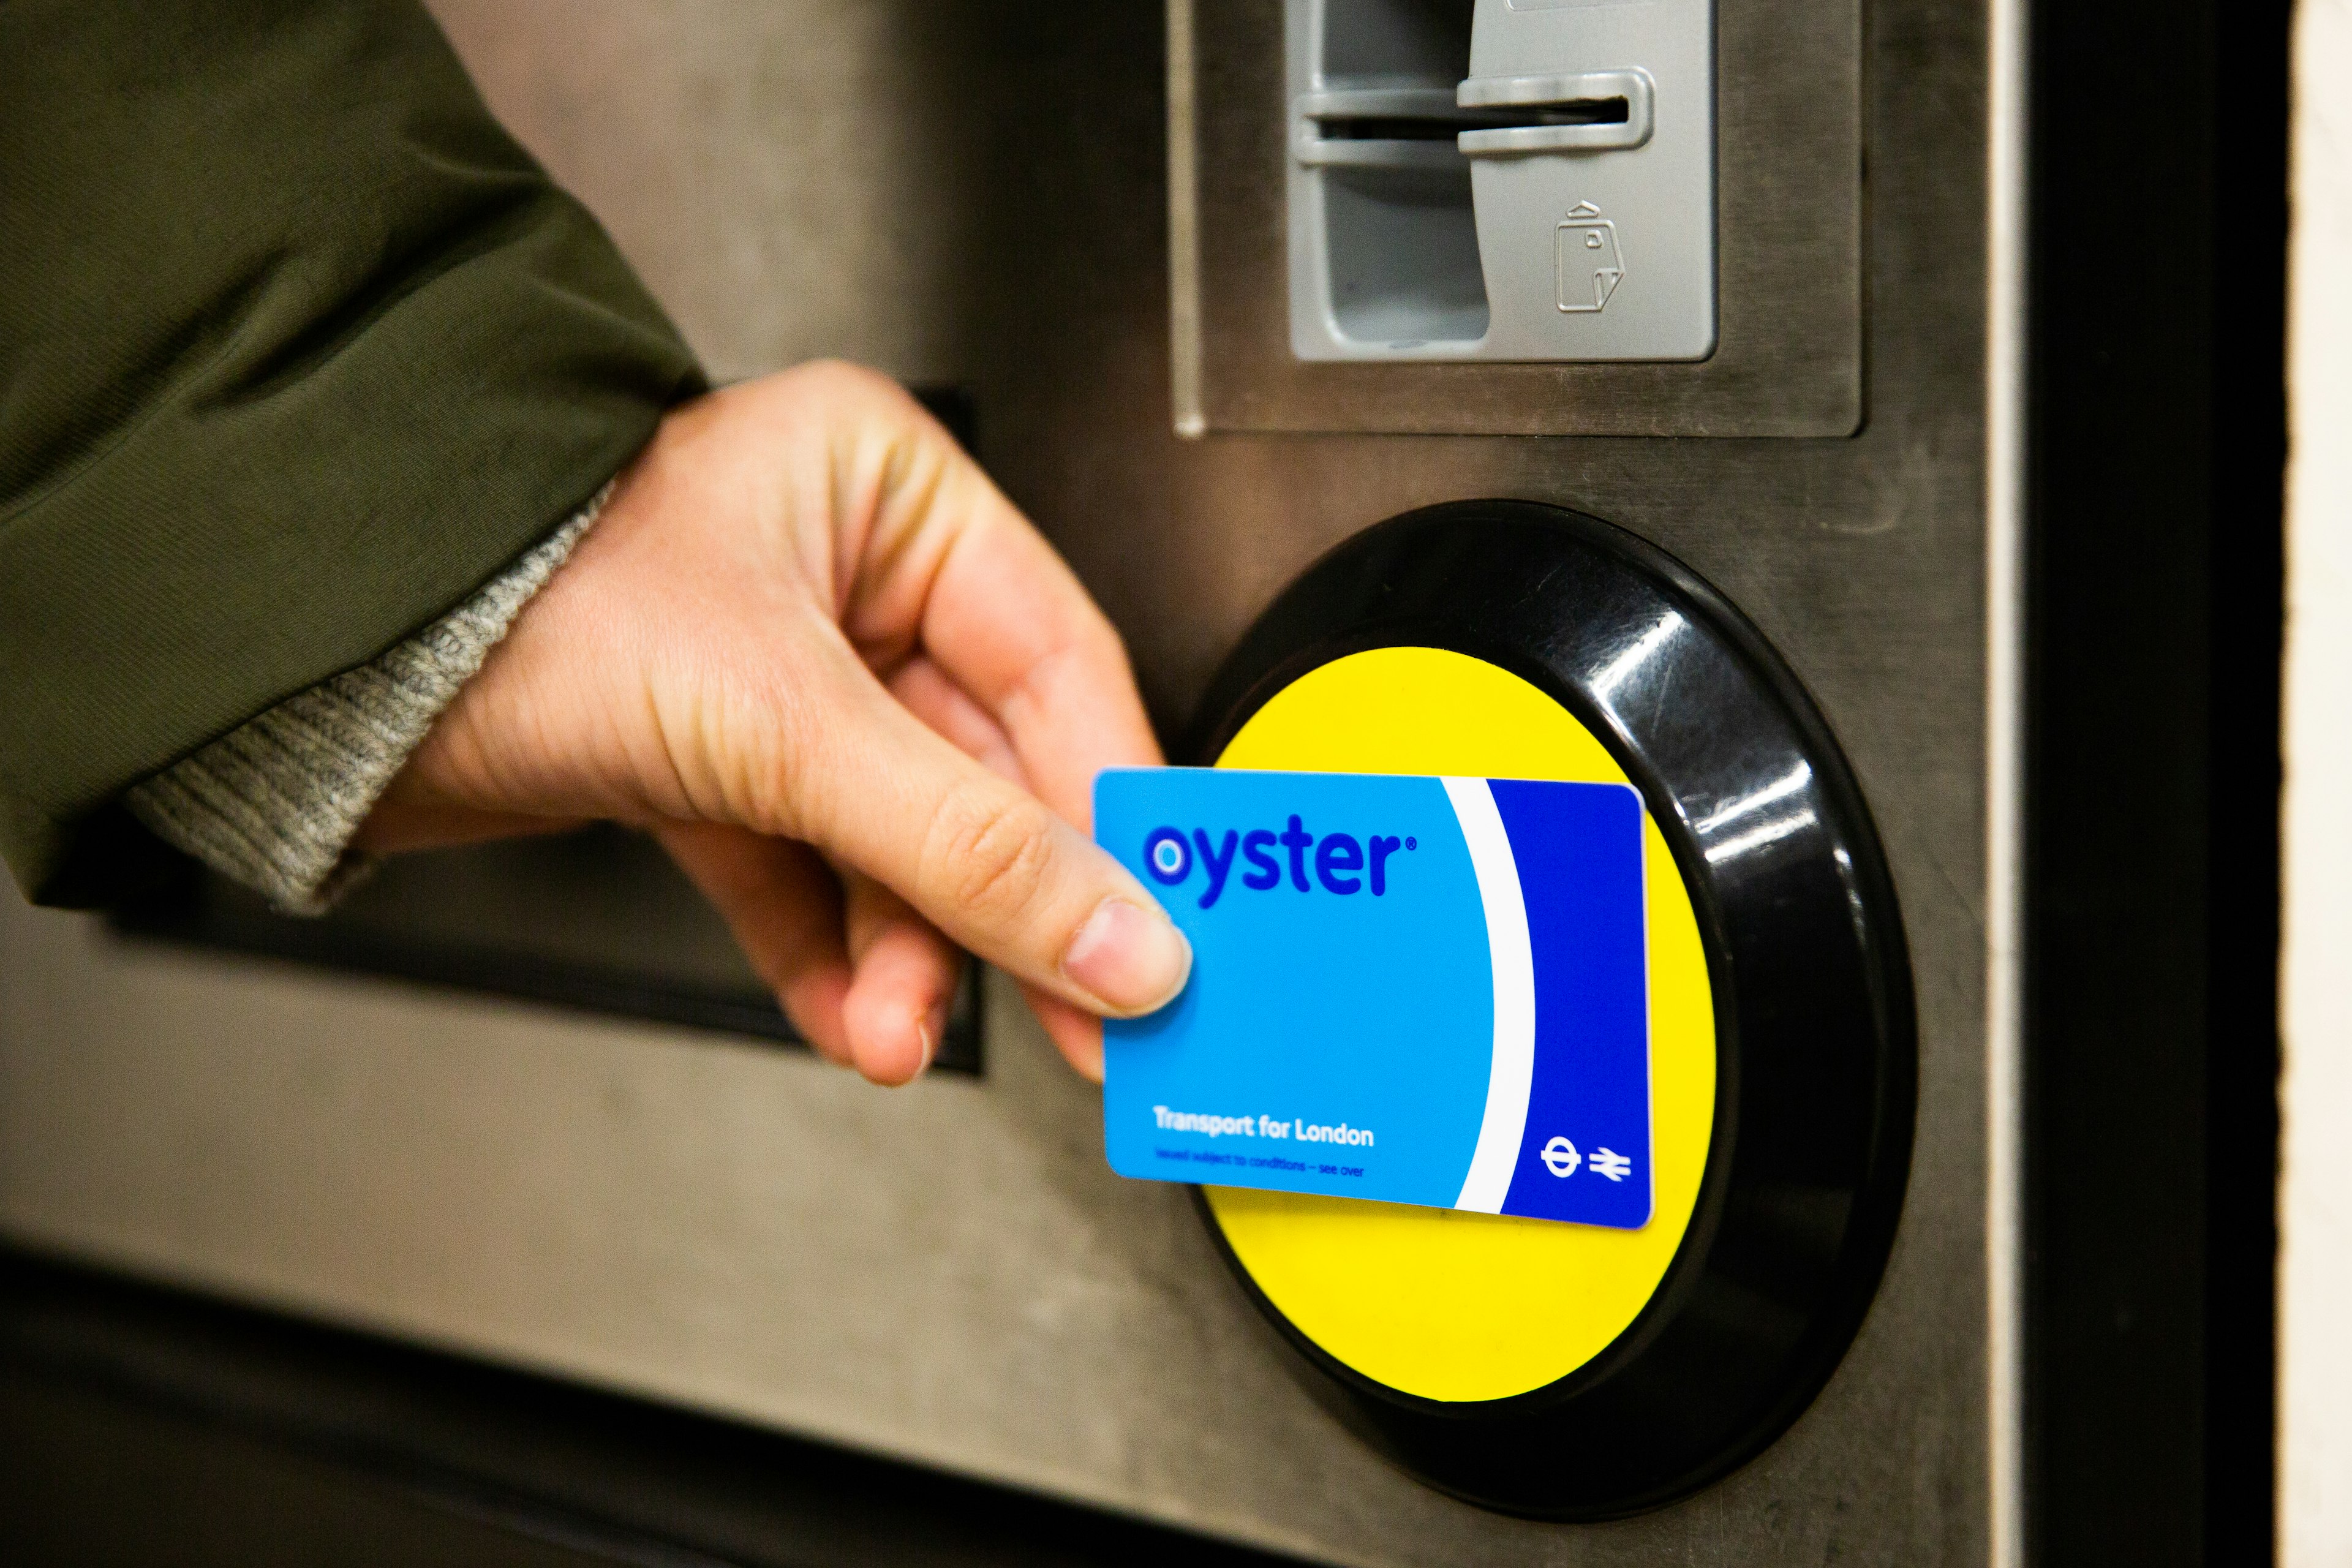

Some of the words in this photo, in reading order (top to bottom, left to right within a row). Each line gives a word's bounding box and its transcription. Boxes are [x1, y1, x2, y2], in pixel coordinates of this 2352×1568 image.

[1154, 1105, 1254, 1137] Transport
[1259, 1114, 1291, 1138] for
[1295, 1118, 1374, 1147] London
[1234, 1155, 1246, 1166] to
[1249, 1157, 1305, 1172] conditions
[1319, 1164, 1337, 1175] see
[1341, 1167, 1364, 1177] over
